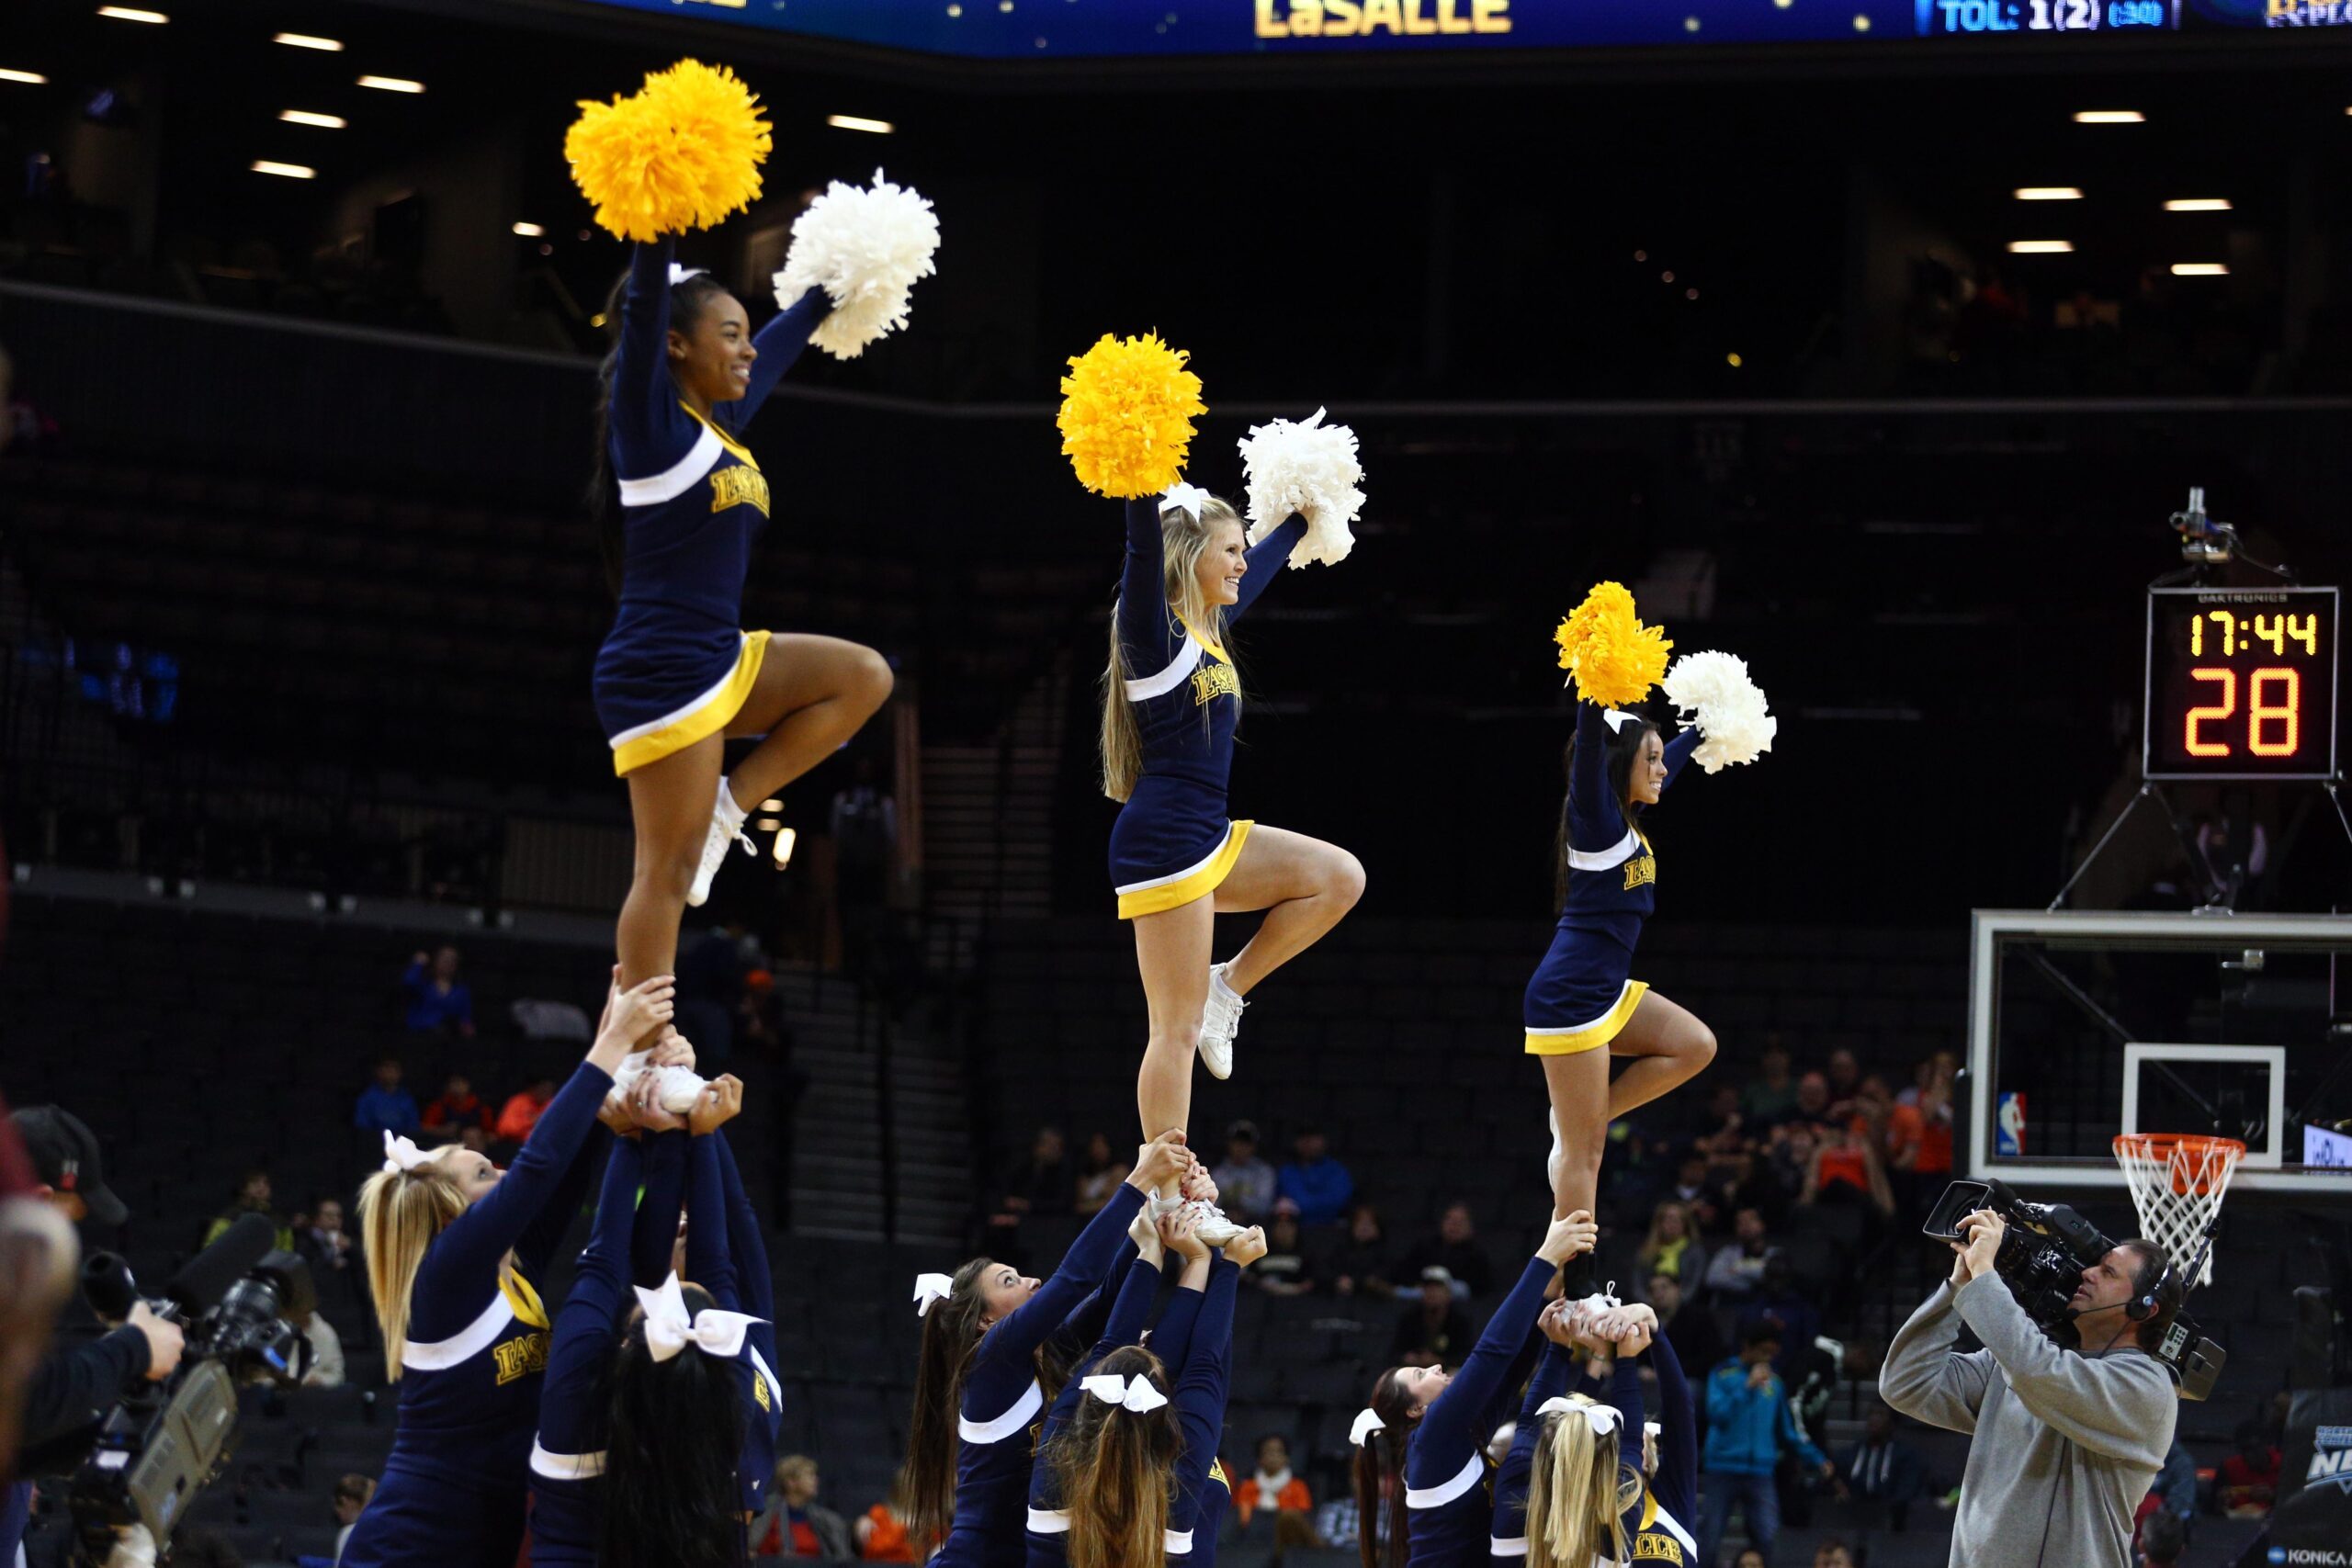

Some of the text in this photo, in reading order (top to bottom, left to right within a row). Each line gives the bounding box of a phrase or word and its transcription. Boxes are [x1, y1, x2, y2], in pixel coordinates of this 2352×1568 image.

[2190, 610, 2317, 657] 17:44
[2185, 668, 2300, 757] 28
[2288, 1549, 2346, 1566] KONICA
